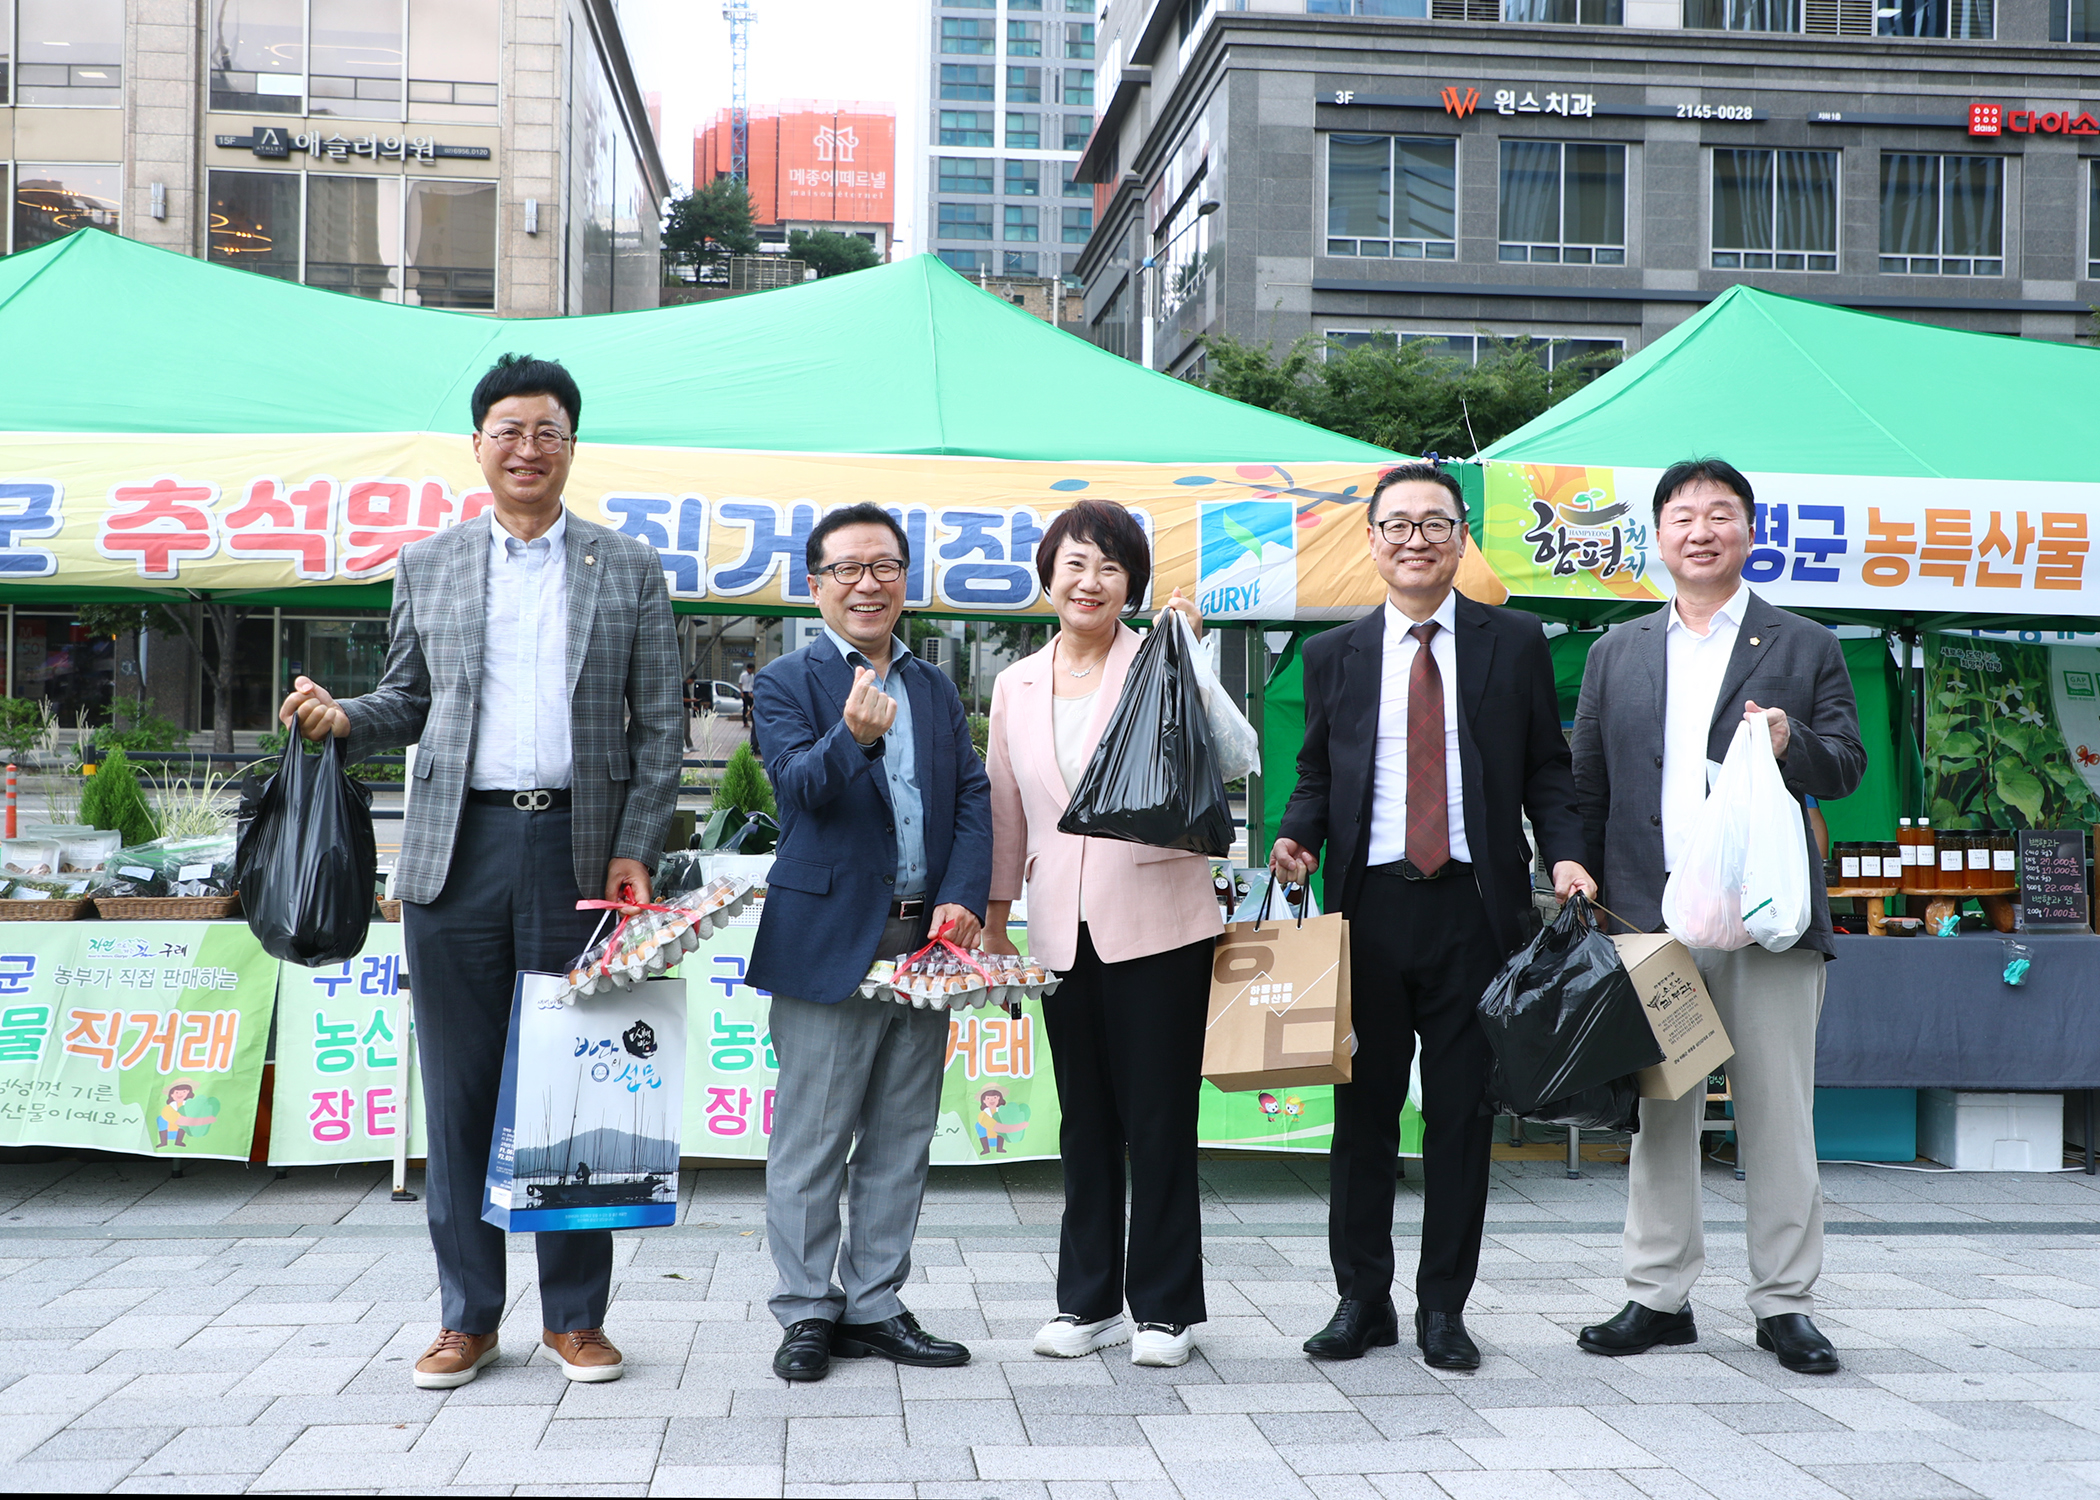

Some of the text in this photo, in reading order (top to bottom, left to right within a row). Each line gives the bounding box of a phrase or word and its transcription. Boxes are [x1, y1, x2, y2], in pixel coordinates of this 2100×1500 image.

[1334, 91, 1354, 105] 3F
[1676, 104, 1753, 121] 2145-0028
[2007, 110, 2100, 135] 다이소
[1973, 124, 1998, 133] daiso
[219, 136, 236, 145] 15F
[102, 478, 494, 573] 추석맞
[1568, 529, 1611, 538] HAMPYEONG
[1525, 501, 1622, 577] 함평
[1861, 506, 2090, 591] 농특산물
[54, 966, 112, 989] 농부가
[119, 968, 155, 989] 직접
[163, 967, 238, 990] 판매하는
[66, 1010, 237, 1075] 직거래
[71, 1084, 114, 1102] 기른
